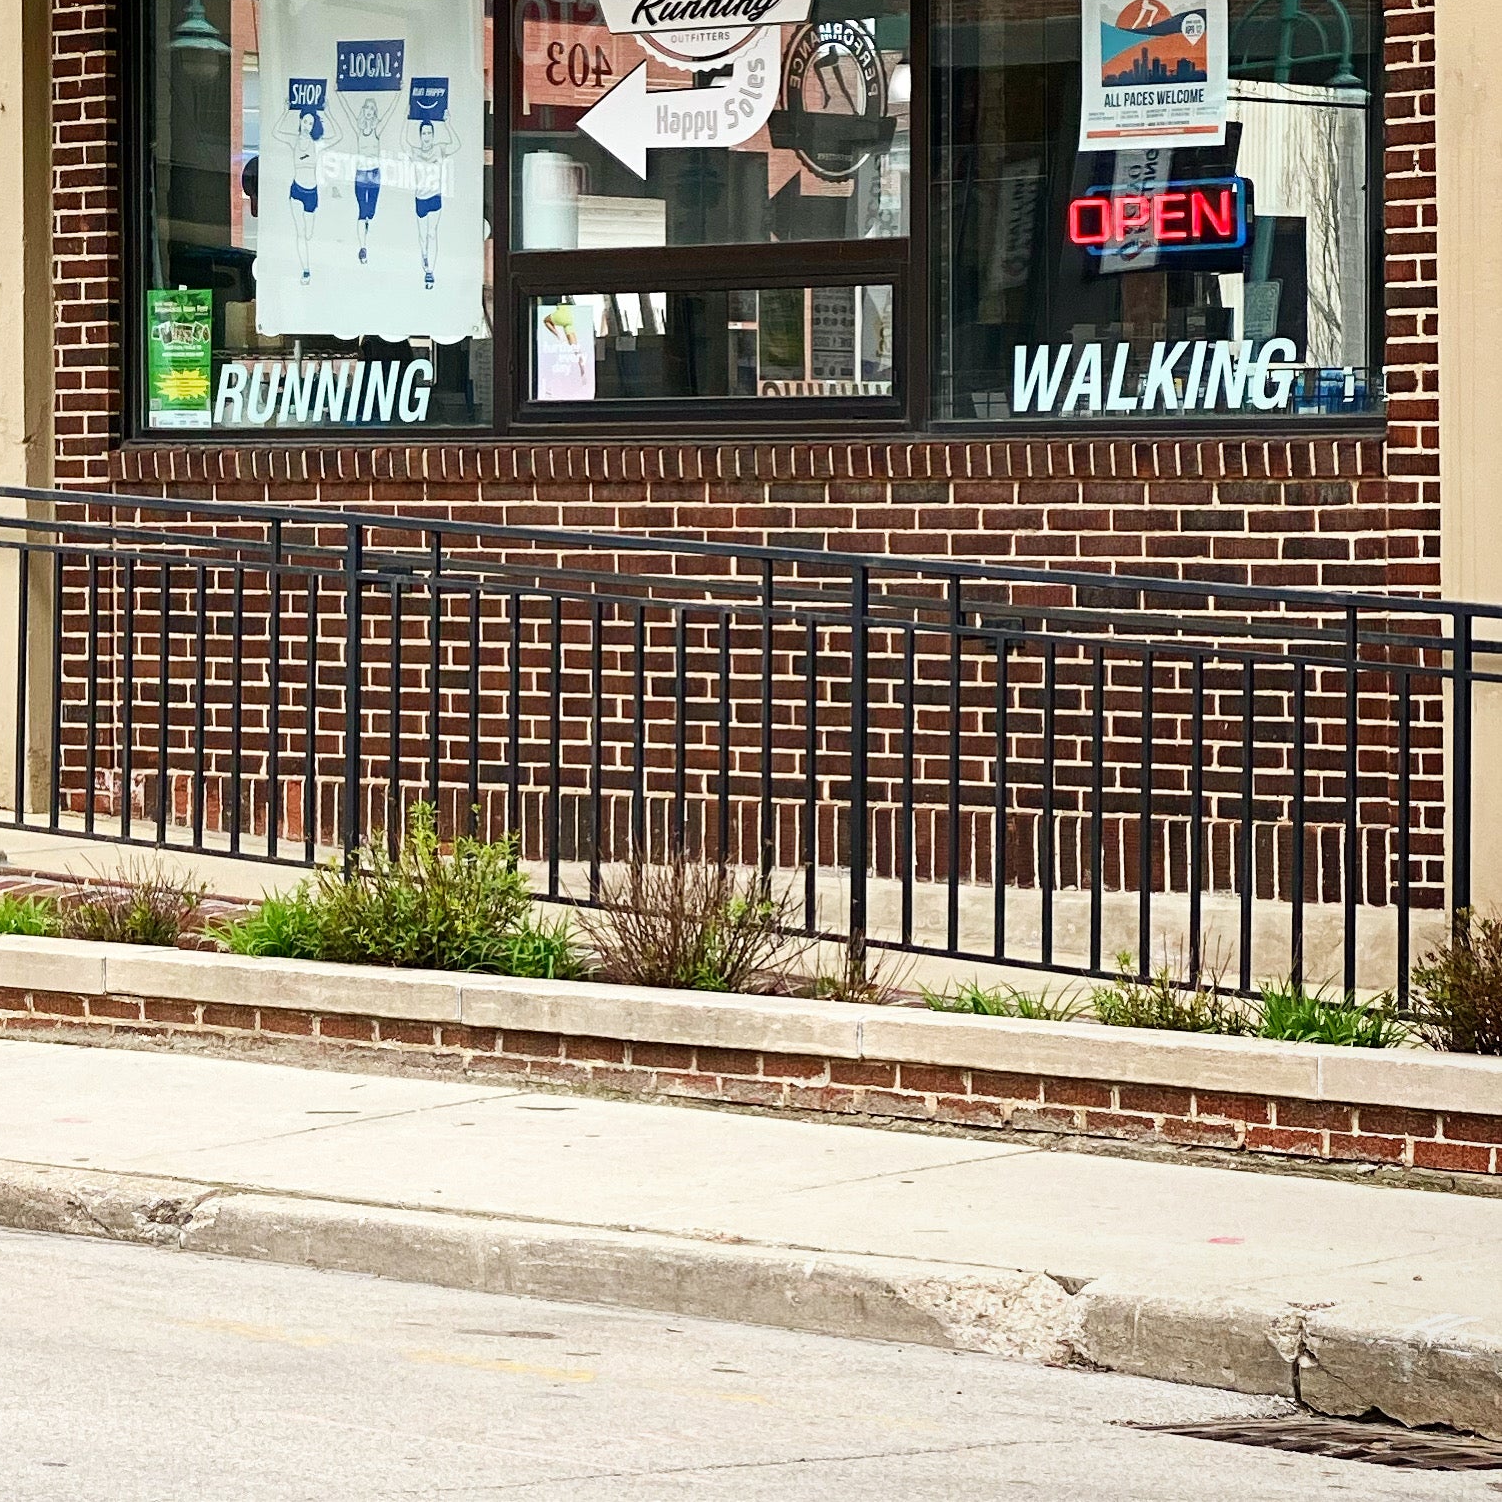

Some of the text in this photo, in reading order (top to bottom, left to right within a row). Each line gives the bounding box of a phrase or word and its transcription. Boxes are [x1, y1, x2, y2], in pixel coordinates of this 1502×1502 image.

[671, 32, 730, 43] OUTFITTERS
[349, 52, 392, 77] LOCAL
[291, 83, 323, 105] SHOP
[656, 58, 766, 141] Happy Soles
[1104, 88, 1204, 108] ALL PACES WELCOME
[1068, 191, 1233, 245] OPEN
[213, 359, 433, 424] RUNNING
[1013, 338, 1298, 412] WALKING
